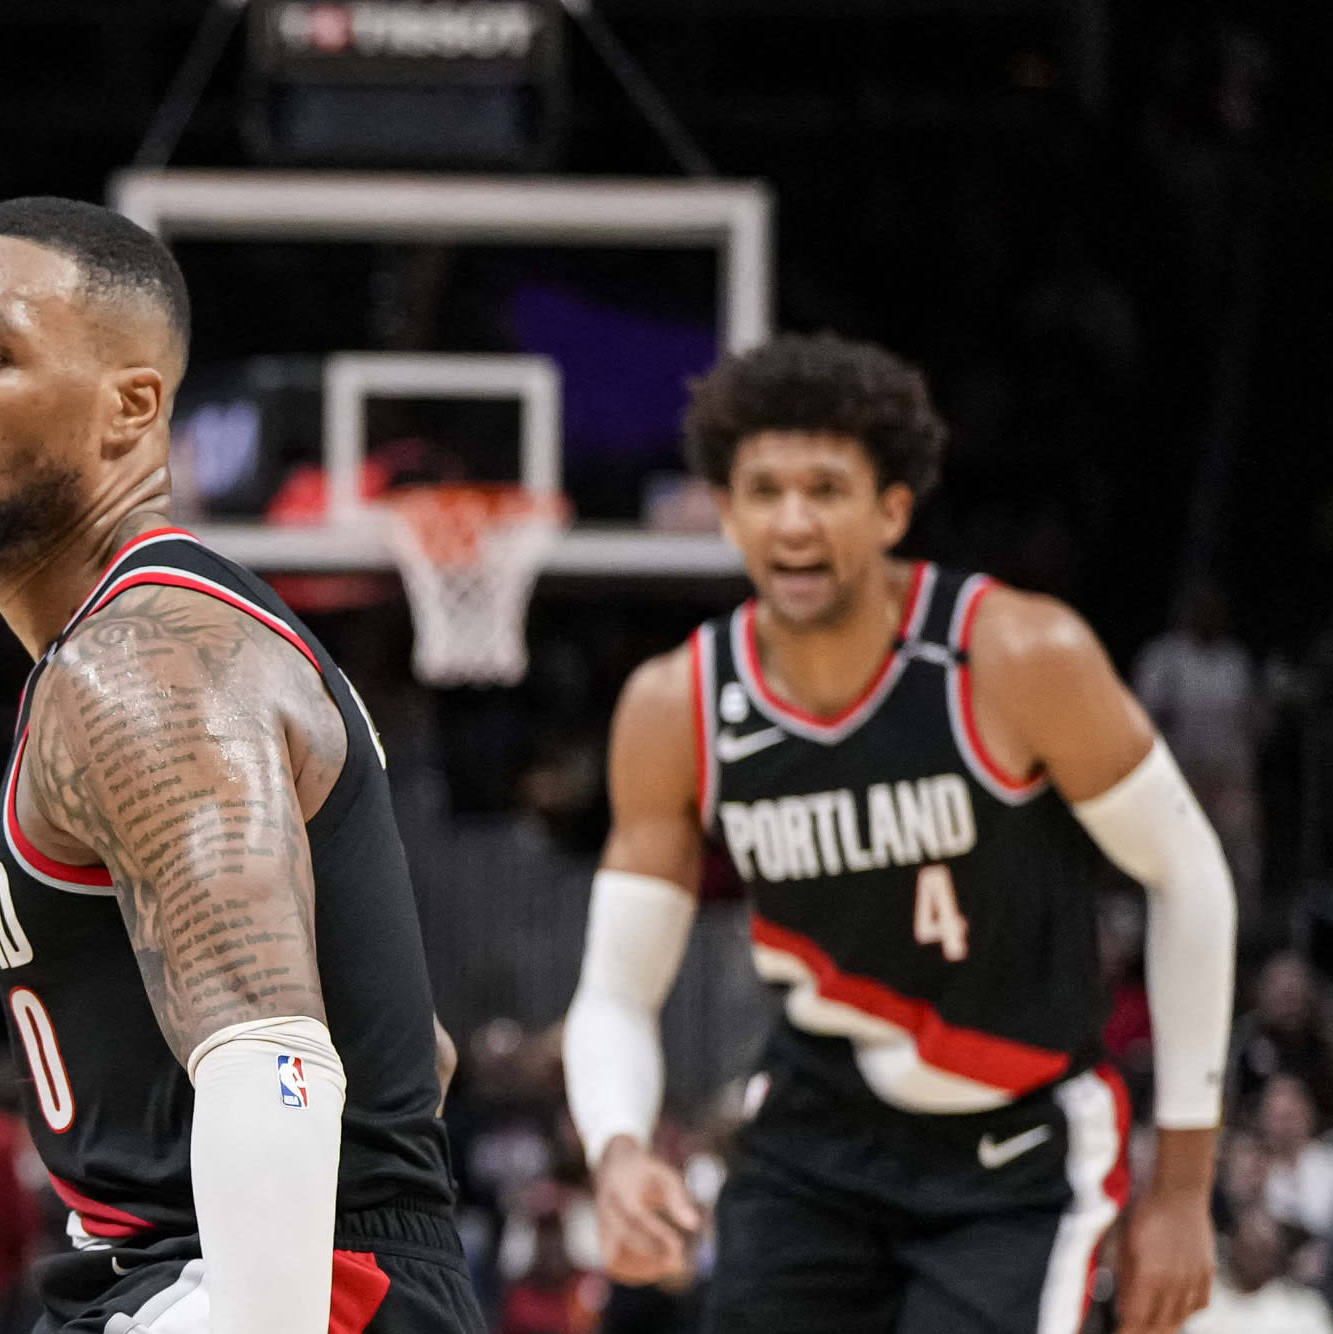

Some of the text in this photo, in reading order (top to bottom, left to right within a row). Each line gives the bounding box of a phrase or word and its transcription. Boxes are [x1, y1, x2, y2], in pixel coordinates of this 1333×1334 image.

[719, 773, 978, 882] PORTLAND
[914, 863, 970, 961] 4
[8, 985, 76, 1134] 0
